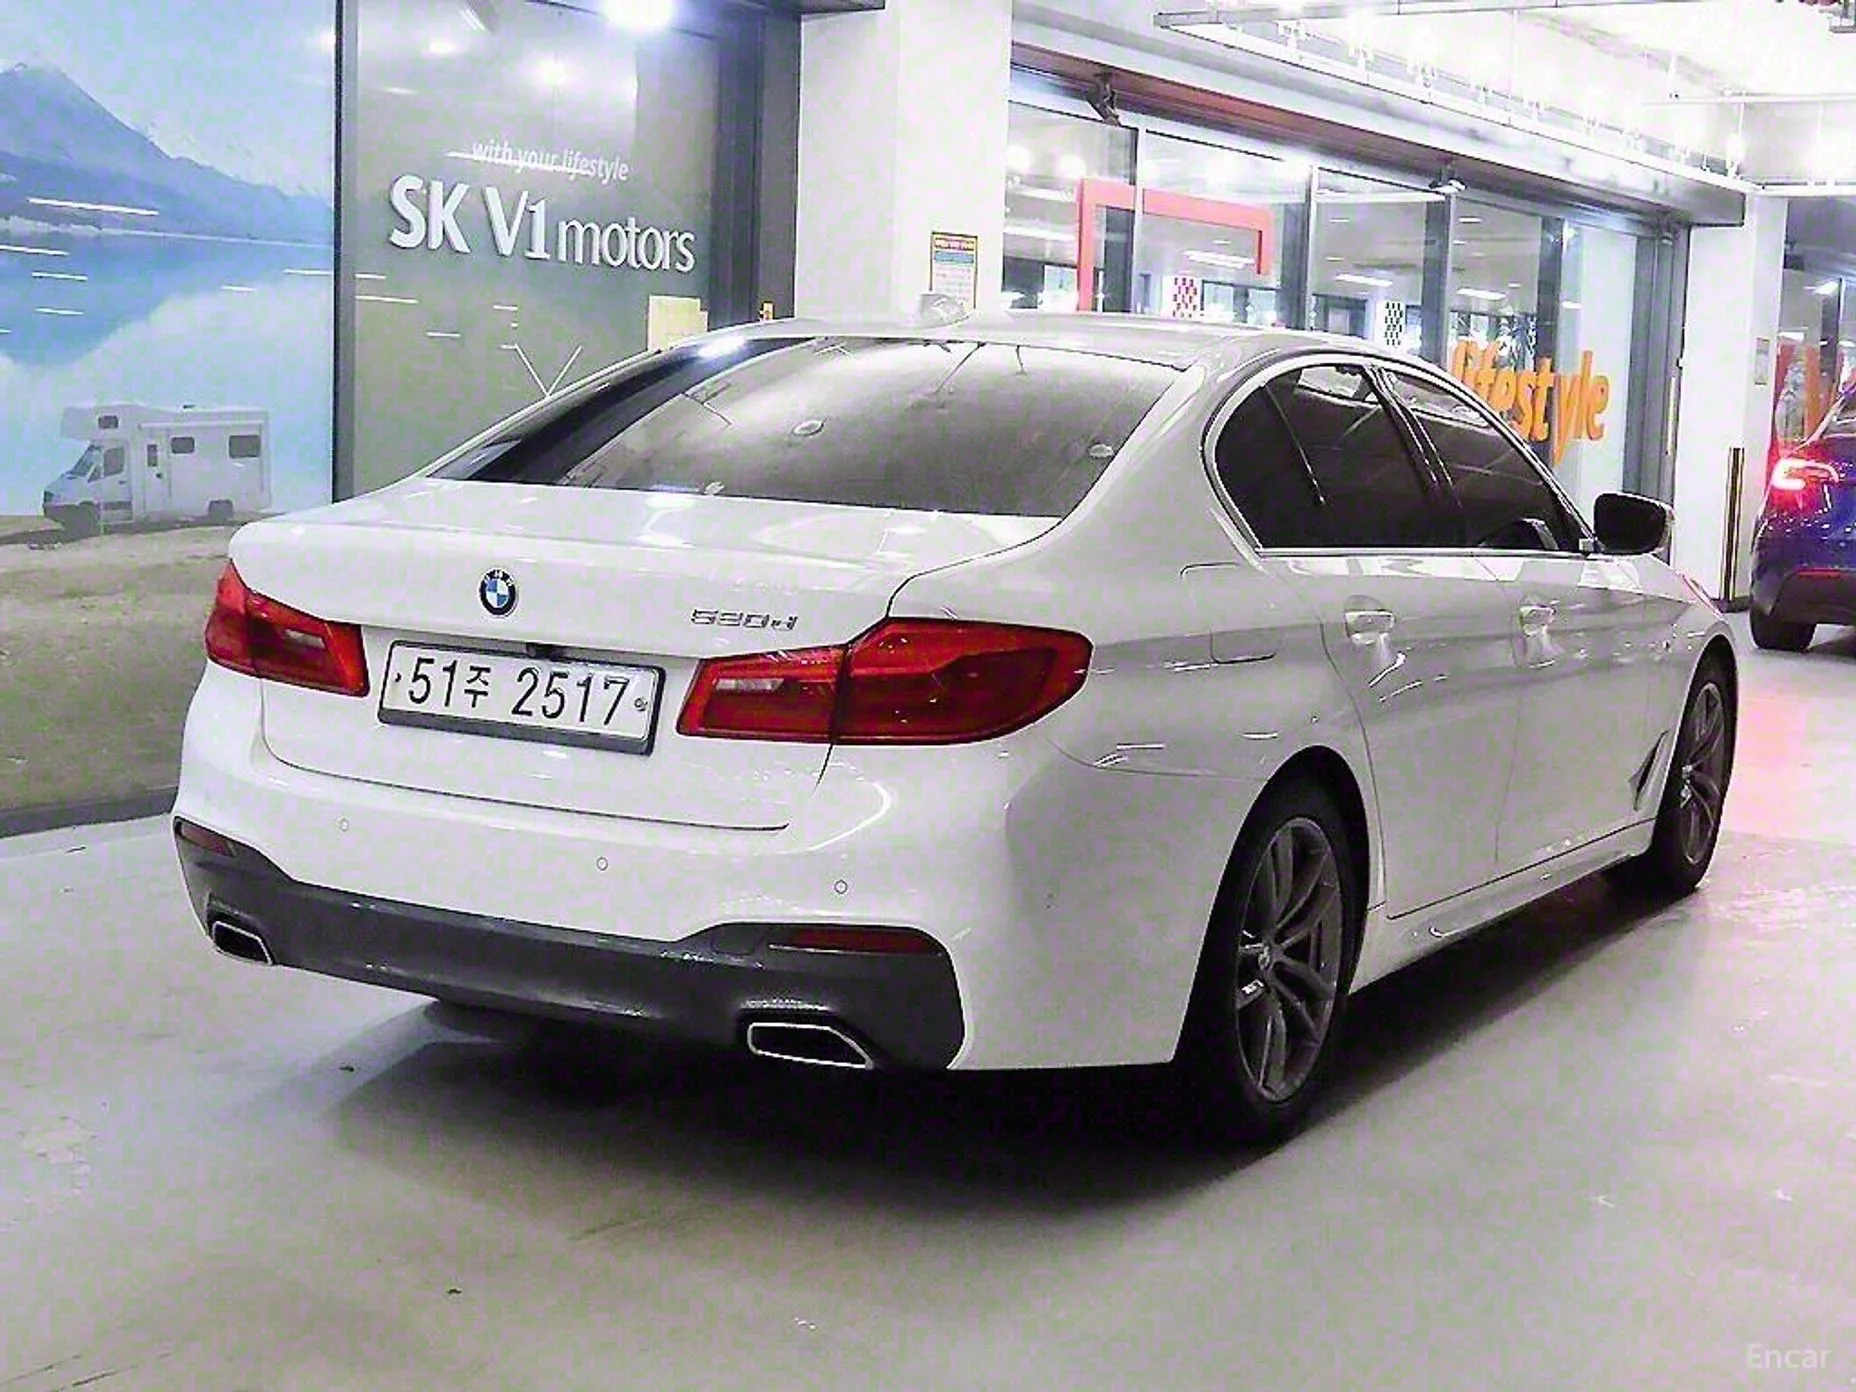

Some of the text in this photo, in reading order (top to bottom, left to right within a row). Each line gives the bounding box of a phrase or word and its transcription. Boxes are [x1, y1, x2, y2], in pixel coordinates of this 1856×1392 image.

[472, 138, 630, 184] with your lifestyle
[388, 173, 696, 273] SK V1 motors
[408, 657, 630, 726] 51주 2517
